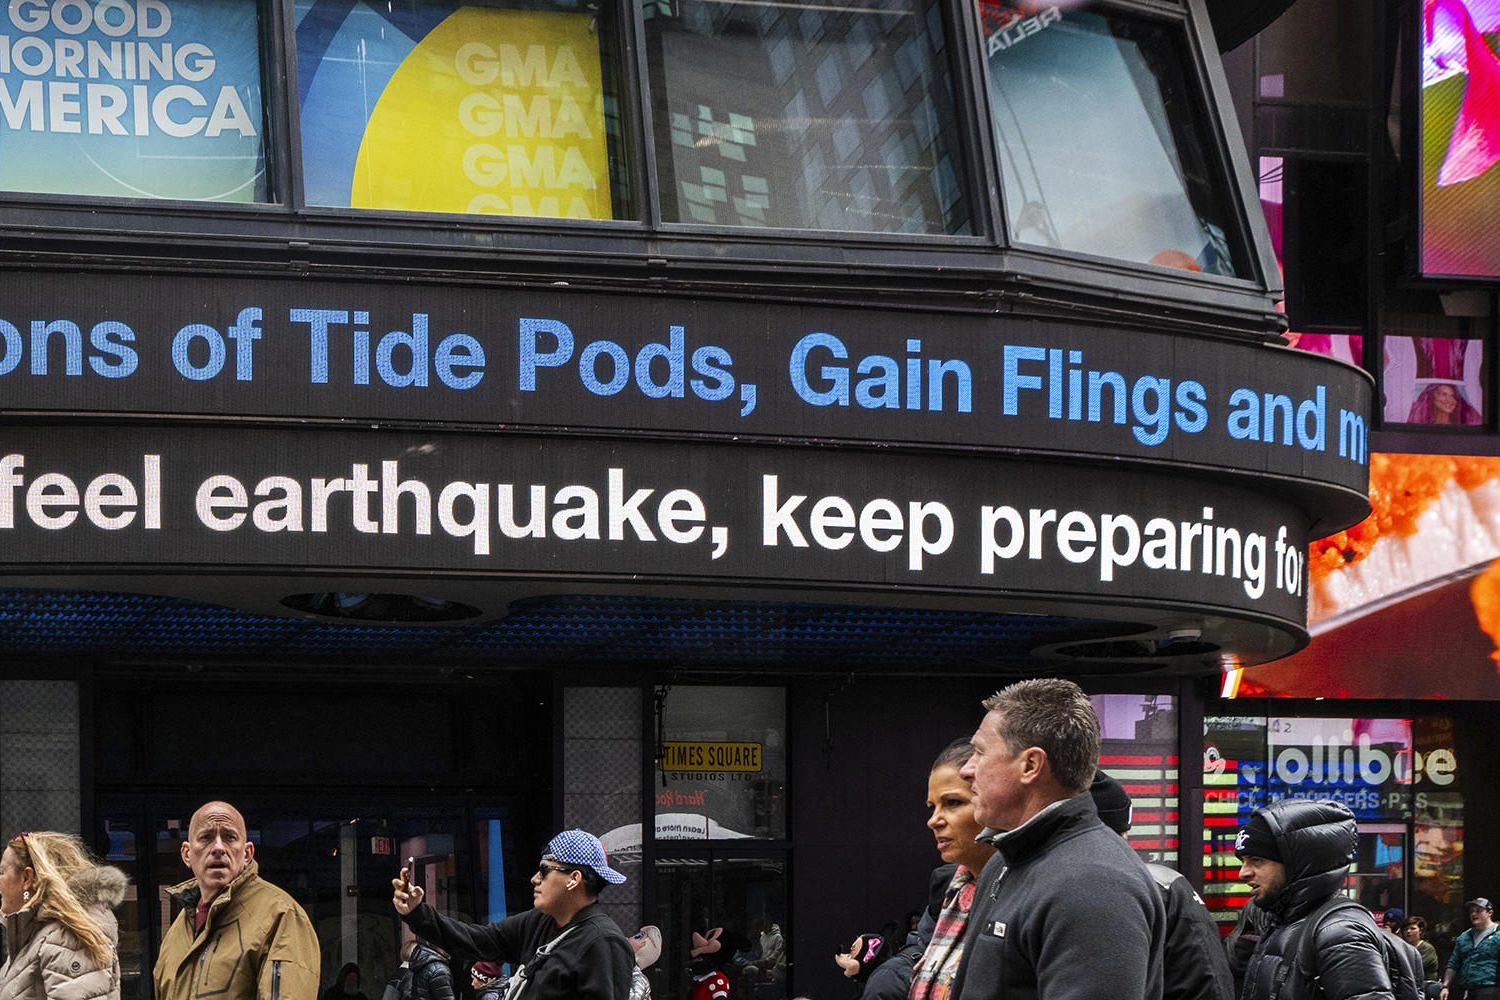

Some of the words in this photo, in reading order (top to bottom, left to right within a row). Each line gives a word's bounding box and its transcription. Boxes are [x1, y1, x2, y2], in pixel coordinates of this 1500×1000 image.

[8, 0, 172, 37] GOOD
[455, 42, 590, 88] GMA
[458, 92, 593, 139] GMA
[462, 143, 597, 190] GMA
[171, 306, 263, 381] of
[290, 308, 486, 390] Tide
[519, 318, 756, 418] Pods,
[789, 333, 973, 412] Gain
[1003, 345, 1209, 447] Flings
[1226, 384, 1327, 452] and
[1338, 408, 1369, 466] m
[195, 461, 728, 559] earthquake,
[762, 475, 955, 571] keep
[980, 505, 1267, 600] preparing
[664, 746, 703, 767] TIMES
[708, 746, 758, 766] SQUARE
[671, 772, 725, 781] STUDIOS
[731, 773, 752, 781] LTD
